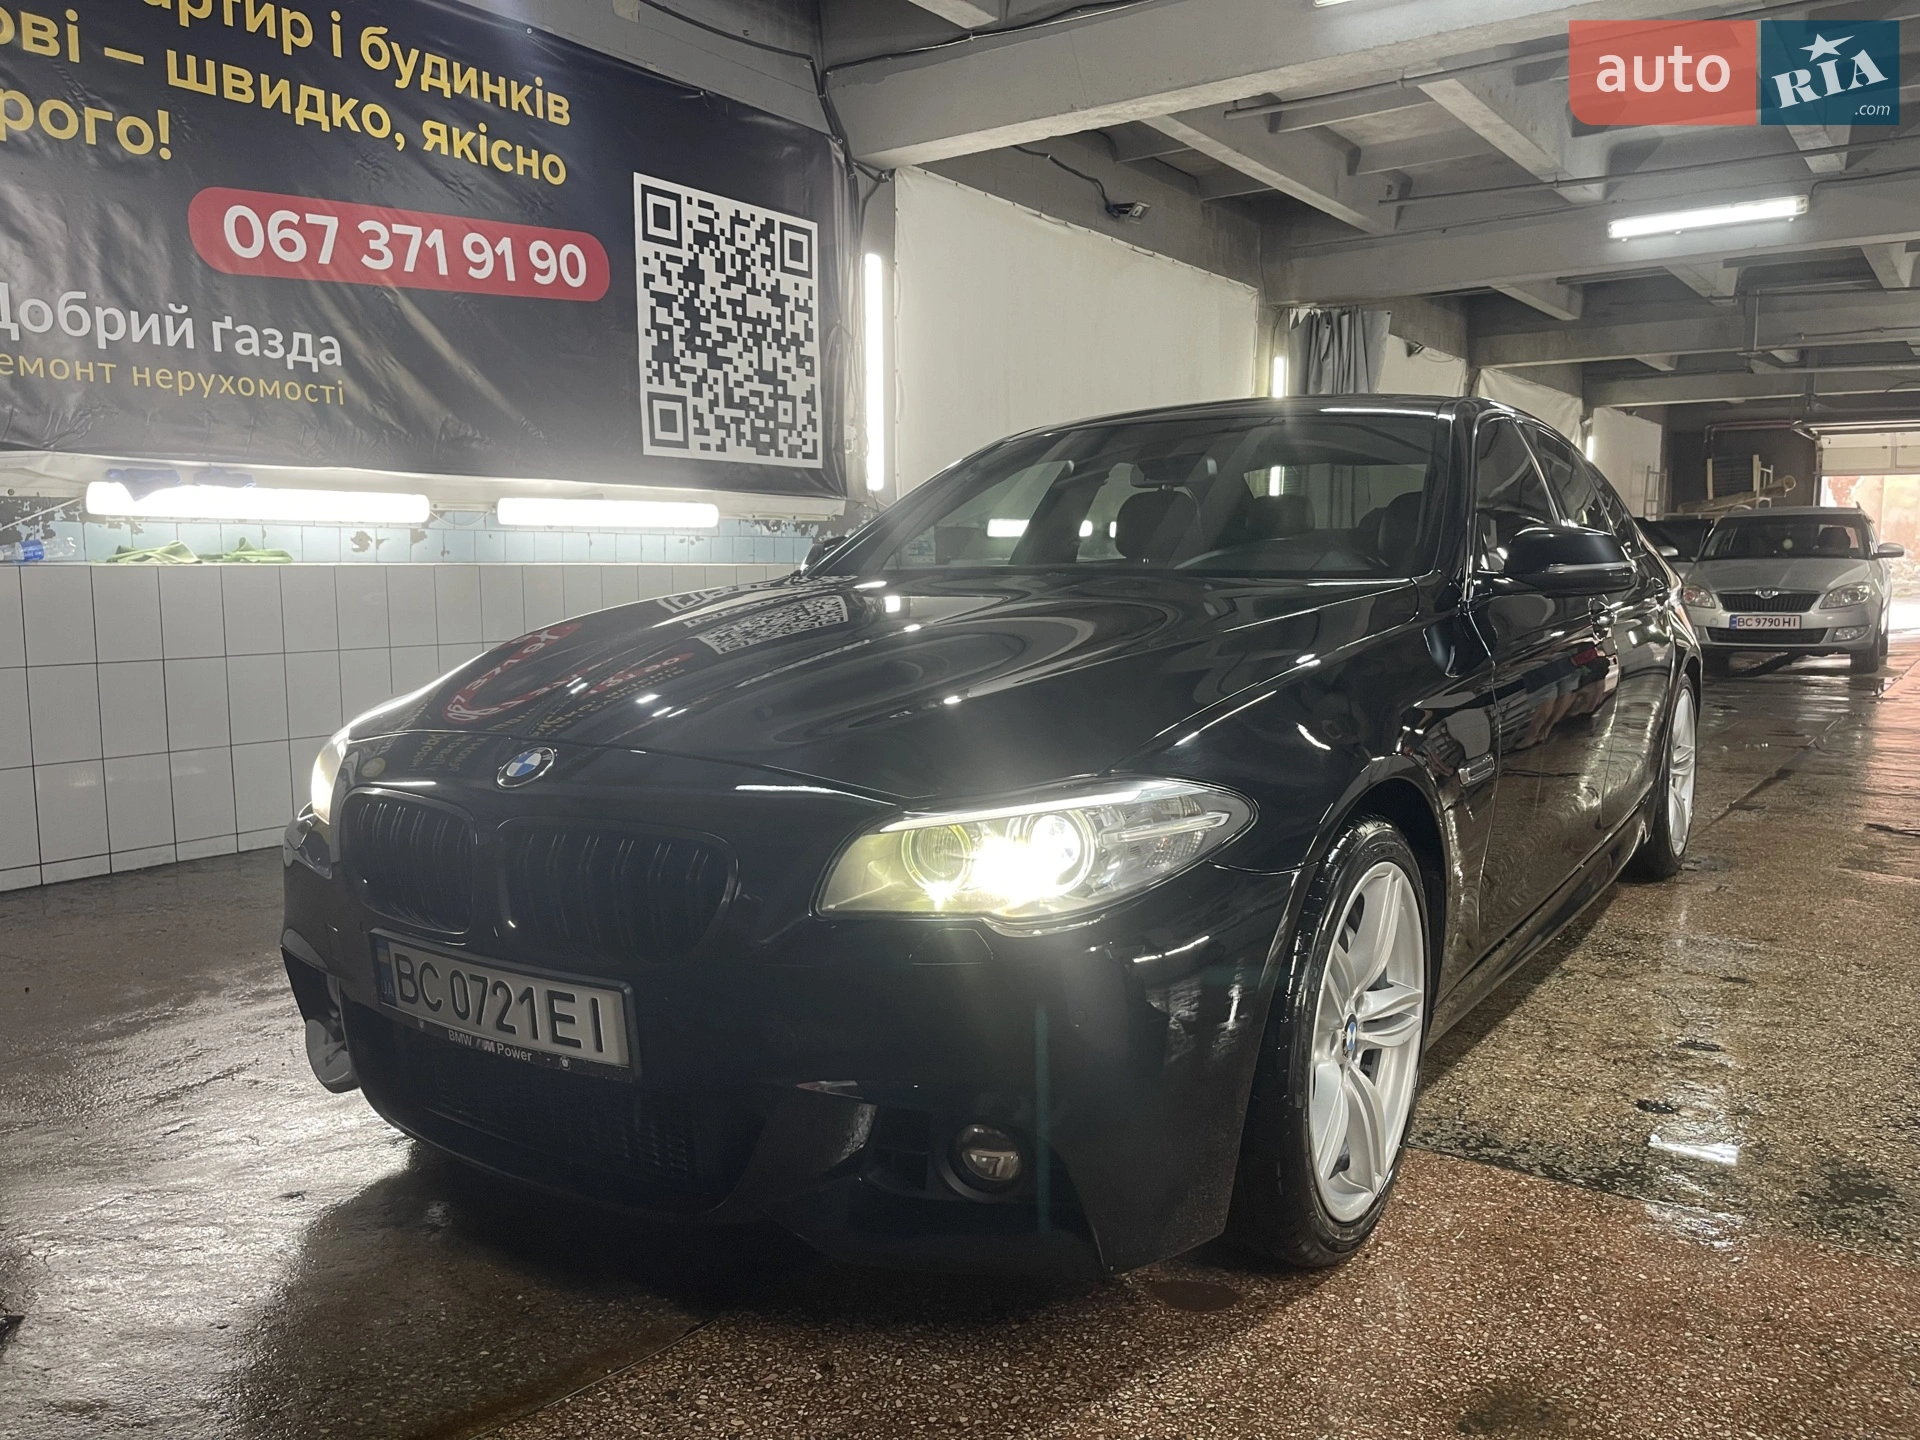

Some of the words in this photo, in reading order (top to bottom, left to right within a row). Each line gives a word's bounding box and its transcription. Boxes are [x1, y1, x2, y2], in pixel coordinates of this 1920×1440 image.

[143, 0, 313, 55] ртир
[331, 10, 342, 58] і
[360, 27, 571, 126] будинків
[167, 49, 405, 151] швидко,
[423, 120, 567, 186] якісно
[223, 204, 339, 265] 067
[358, 220, 448, 275] 371
[463, 232, 516, 282] 91
[529, 241, 586, 287] 90
[212, 315, 342, 366] ґазда
[132, 365, 344, 405] нерухомості
[1737, 617, 1753, 627] BC
[1755, 617, 1780, 627] 9790
[394, 952, 442, 1012] BC
[450, 970, 539, 1041] 0721
[448, 1029, 472, 1047] BMW
[496, 1042, 532, 1062] Power
